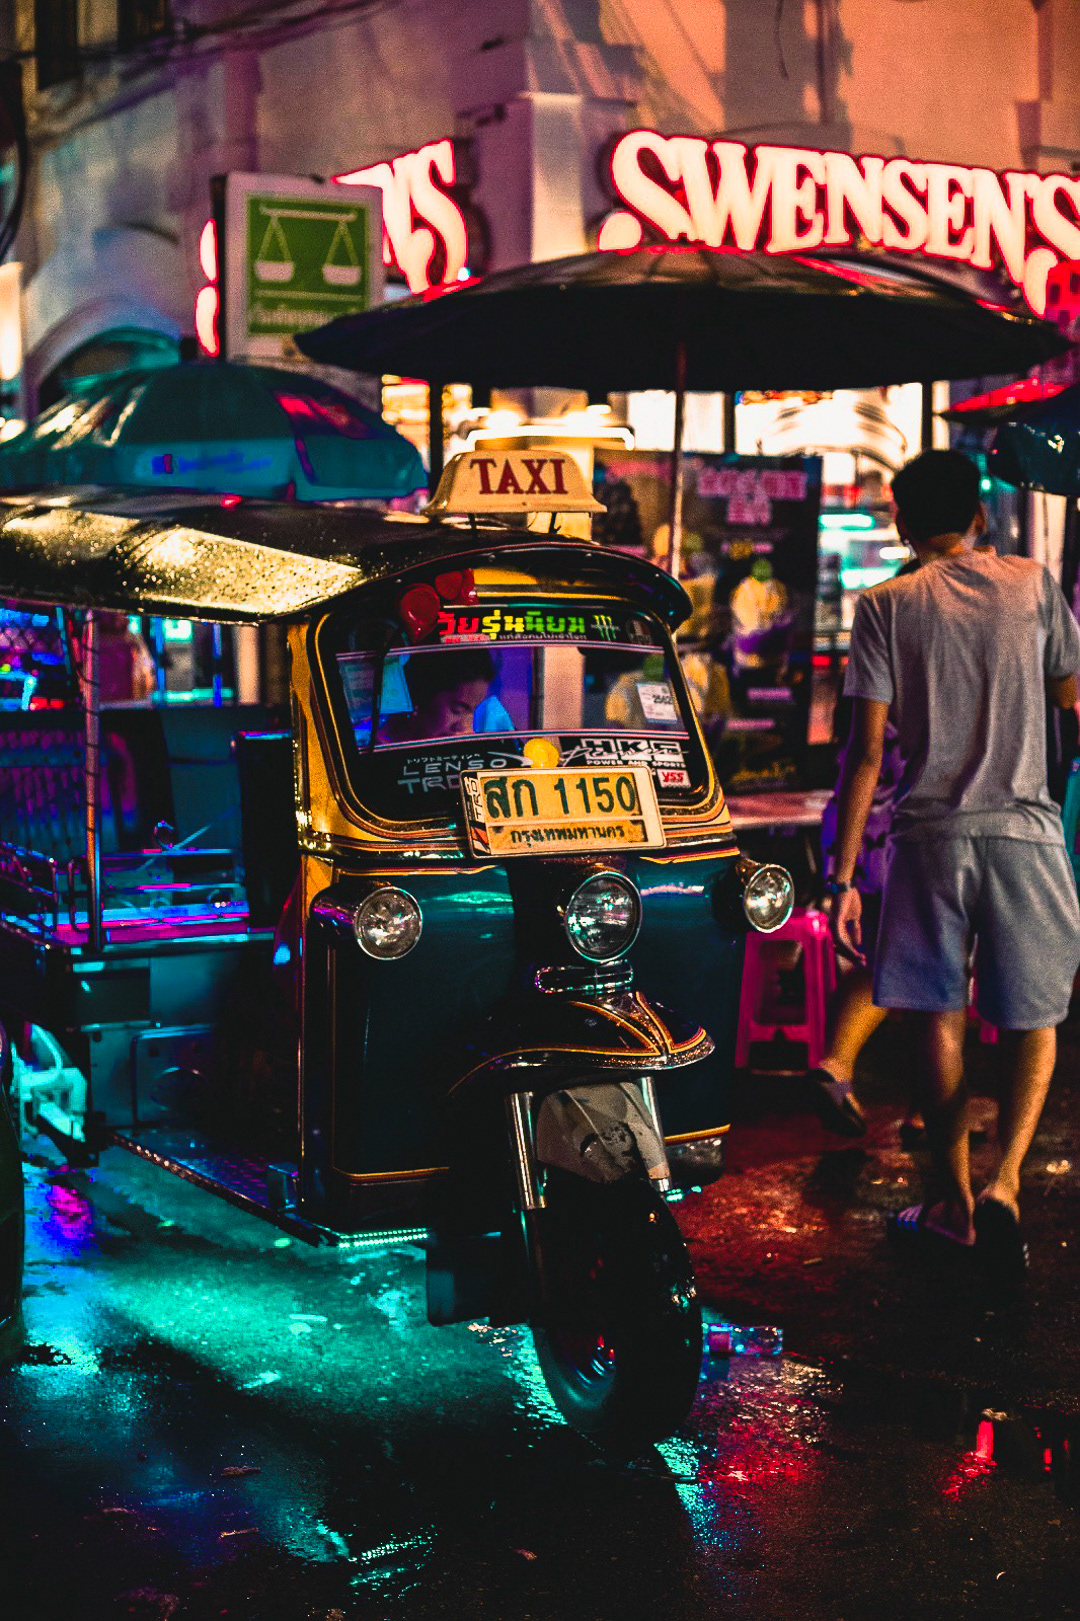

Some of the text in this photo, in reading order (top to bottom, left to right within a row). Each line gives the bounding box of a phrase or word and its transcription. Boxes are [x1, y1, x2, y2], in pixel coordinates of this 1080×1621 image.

[470, 458, 568, 494] TAXI
[403, 758, 507, 776] LENSO
[651, 760, 687, 769] SPORTS
[483, 776, 540, 818] สก
[553, 776, 636, 815] 1150
[510, 825, 625, 848] กรุงเทพมหานคร
